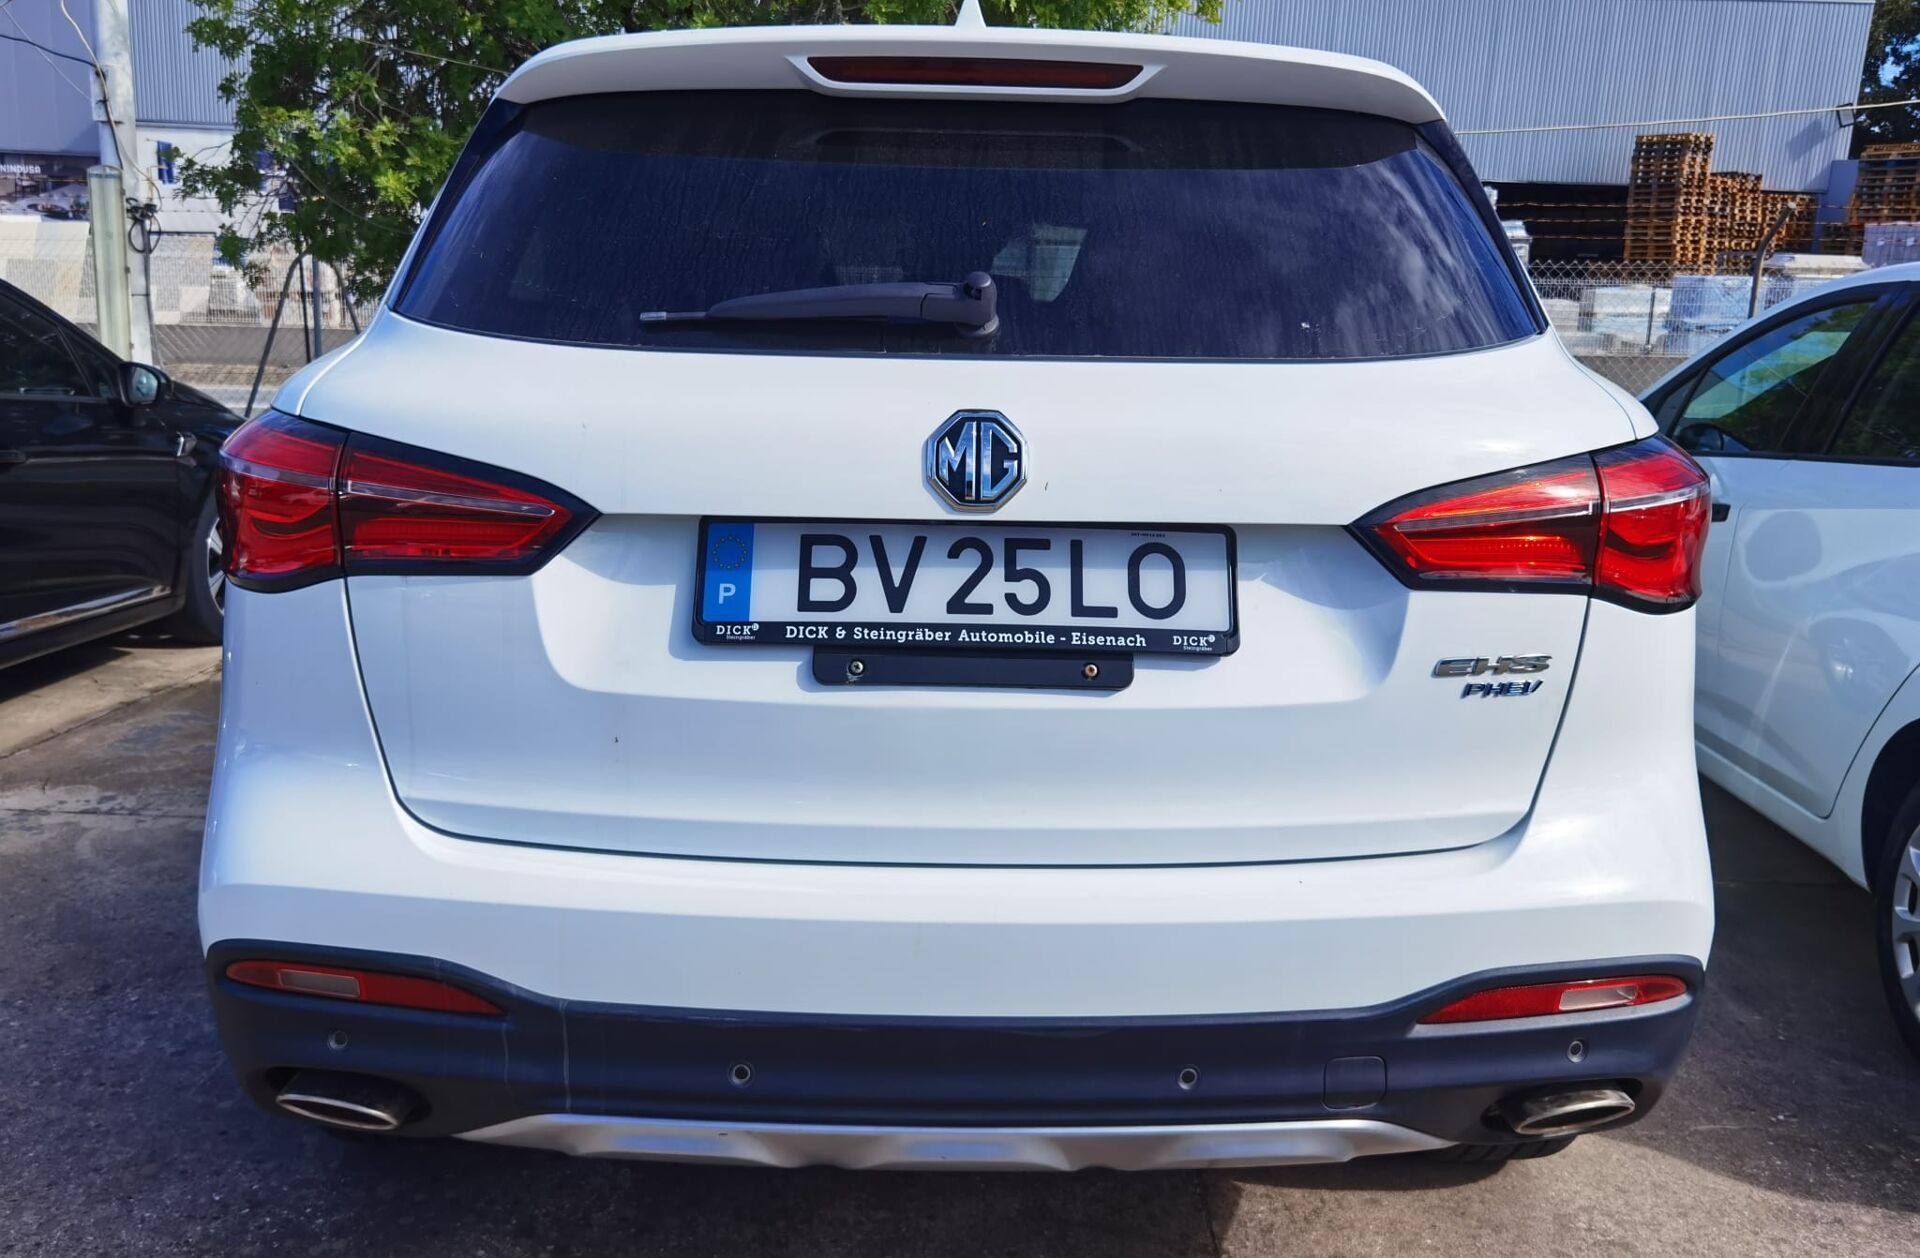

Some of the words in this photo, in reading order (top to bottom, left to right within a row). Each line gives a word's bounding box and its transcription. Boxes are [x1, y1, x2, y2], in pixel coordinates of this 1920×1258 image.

[939, 420, 1018, 500] MG
[718, 583, 736, 604] P
[785, 626, 828, 638] DICK
[836, 627, 847, 639] &
[853, 627, 952, 642] Steingräber
[958, 629, 1055, 644] Automobile
[1071, 632, 1147, 647] Eisenach
[1431, 653, 1552, 677] EHS
[1460, 680, 1544, 698] PHEV
